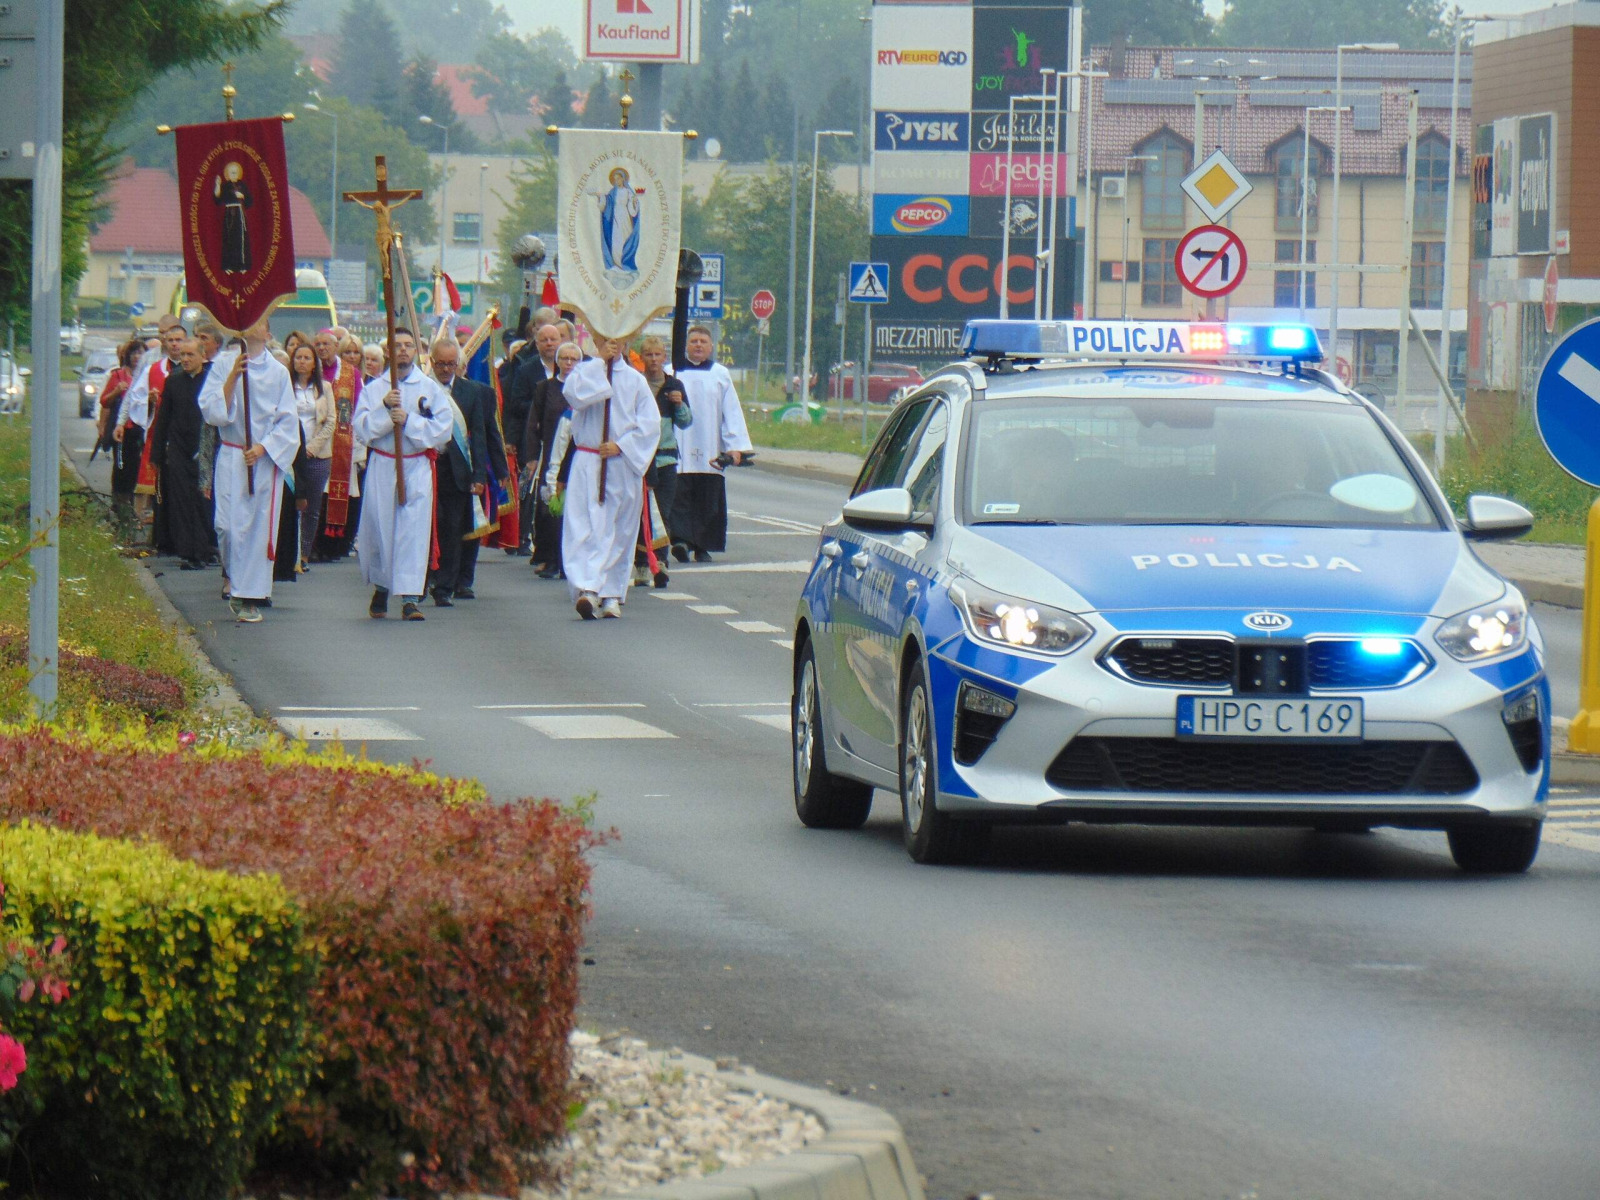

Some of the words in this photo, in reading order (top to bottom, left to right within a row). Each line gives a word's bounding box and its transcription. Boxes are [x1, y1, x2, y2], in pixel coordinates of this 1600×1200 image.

[597, 24, 670, 40] Kaufland
[877, 50, 903, 65] RTV
[904, 52, 938, 63] EURO
[938, 50, 968, 66] AGD
[975, 75, 1004, 91] JOY
[900, 121, 959, 142] JYSK
[627, 151, 637, 161] ZA
[995, 156, 1055, 181] hebe
[1520, 127, 1549, 226] empik
[192, 192, 199, 202] OD
[200, 160, 210, 174] GDY
[270, 190, 277, 200] ZA
[1473, 155, 1488, 203] CCC
[900, 209, 944, 221] PEPCO
[568, 210, 576, 248] GRZECHU
[661, 229, 669, 242] DO
[572, 251, 582, 264] BEZ
[655, 243, 668, 268] CIEBIE
[902, 253, 1035, 304] CCC
[754, 300, 773, 310] STOP
[876, 325, 960, 348] MEZZANINE
[1073, 327, 1185, 353] POLICJA
[1131, 553, 1362, 573] POLICJA
[1253, 615, 1284, 625] KIA
[1181, 720, 1193, 729] PL
[1201, 702, 1262, 732] HPG
[1275, 703, 1354, 734] C169
